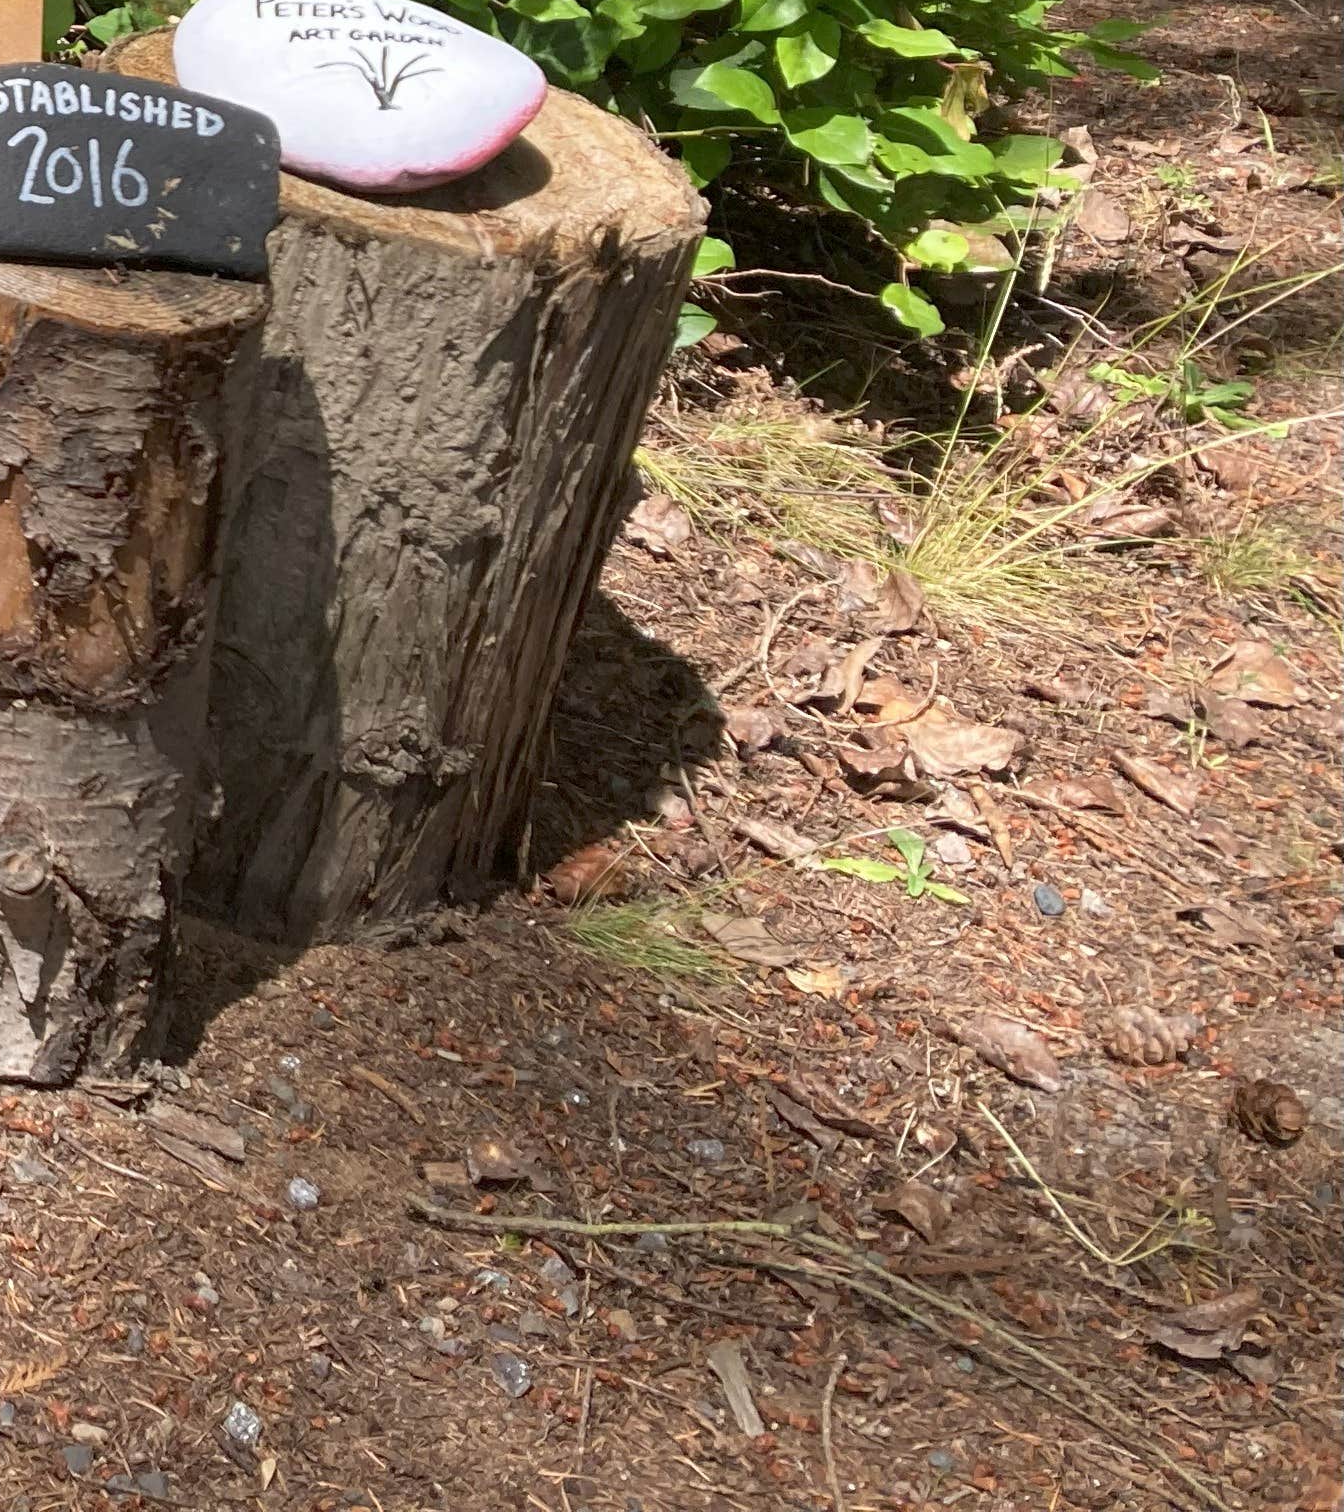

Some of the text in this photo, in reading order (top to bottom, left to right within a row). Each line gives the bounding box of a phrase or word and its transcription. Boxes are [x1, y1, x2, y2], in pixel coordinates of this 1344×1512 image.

[289, 27, 445, 47] ART GARDEN
[6, 125, 149, 208] 2016
